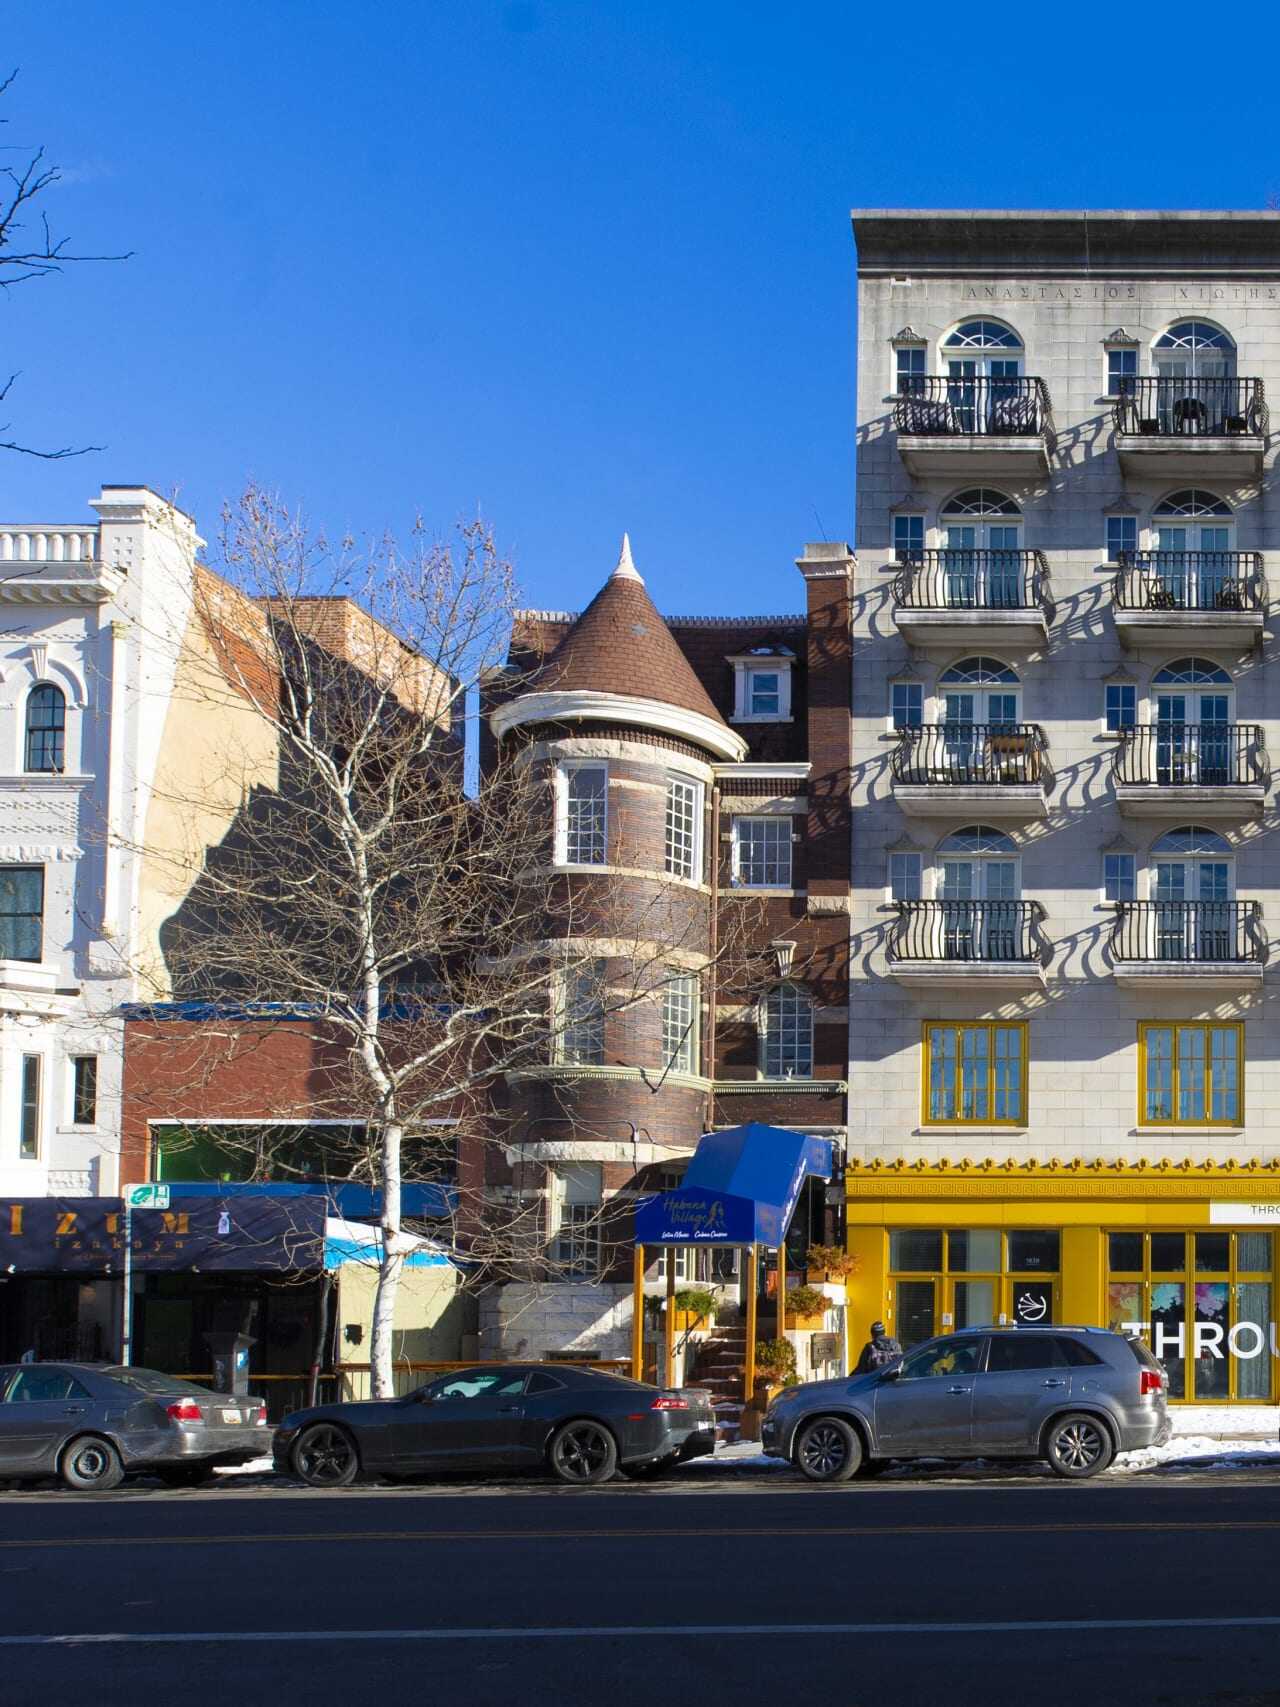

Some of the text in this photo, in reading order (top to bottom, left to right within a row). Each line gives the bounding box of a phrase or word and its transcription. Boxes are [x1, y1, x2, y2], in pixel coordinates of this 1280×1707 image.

[966, 287, 1278, 299] ΑΝΑΣΤΑΣΙΟΣ ΧΙΩΤΗΣ
[664, 1197, 706, 1211] Habana
